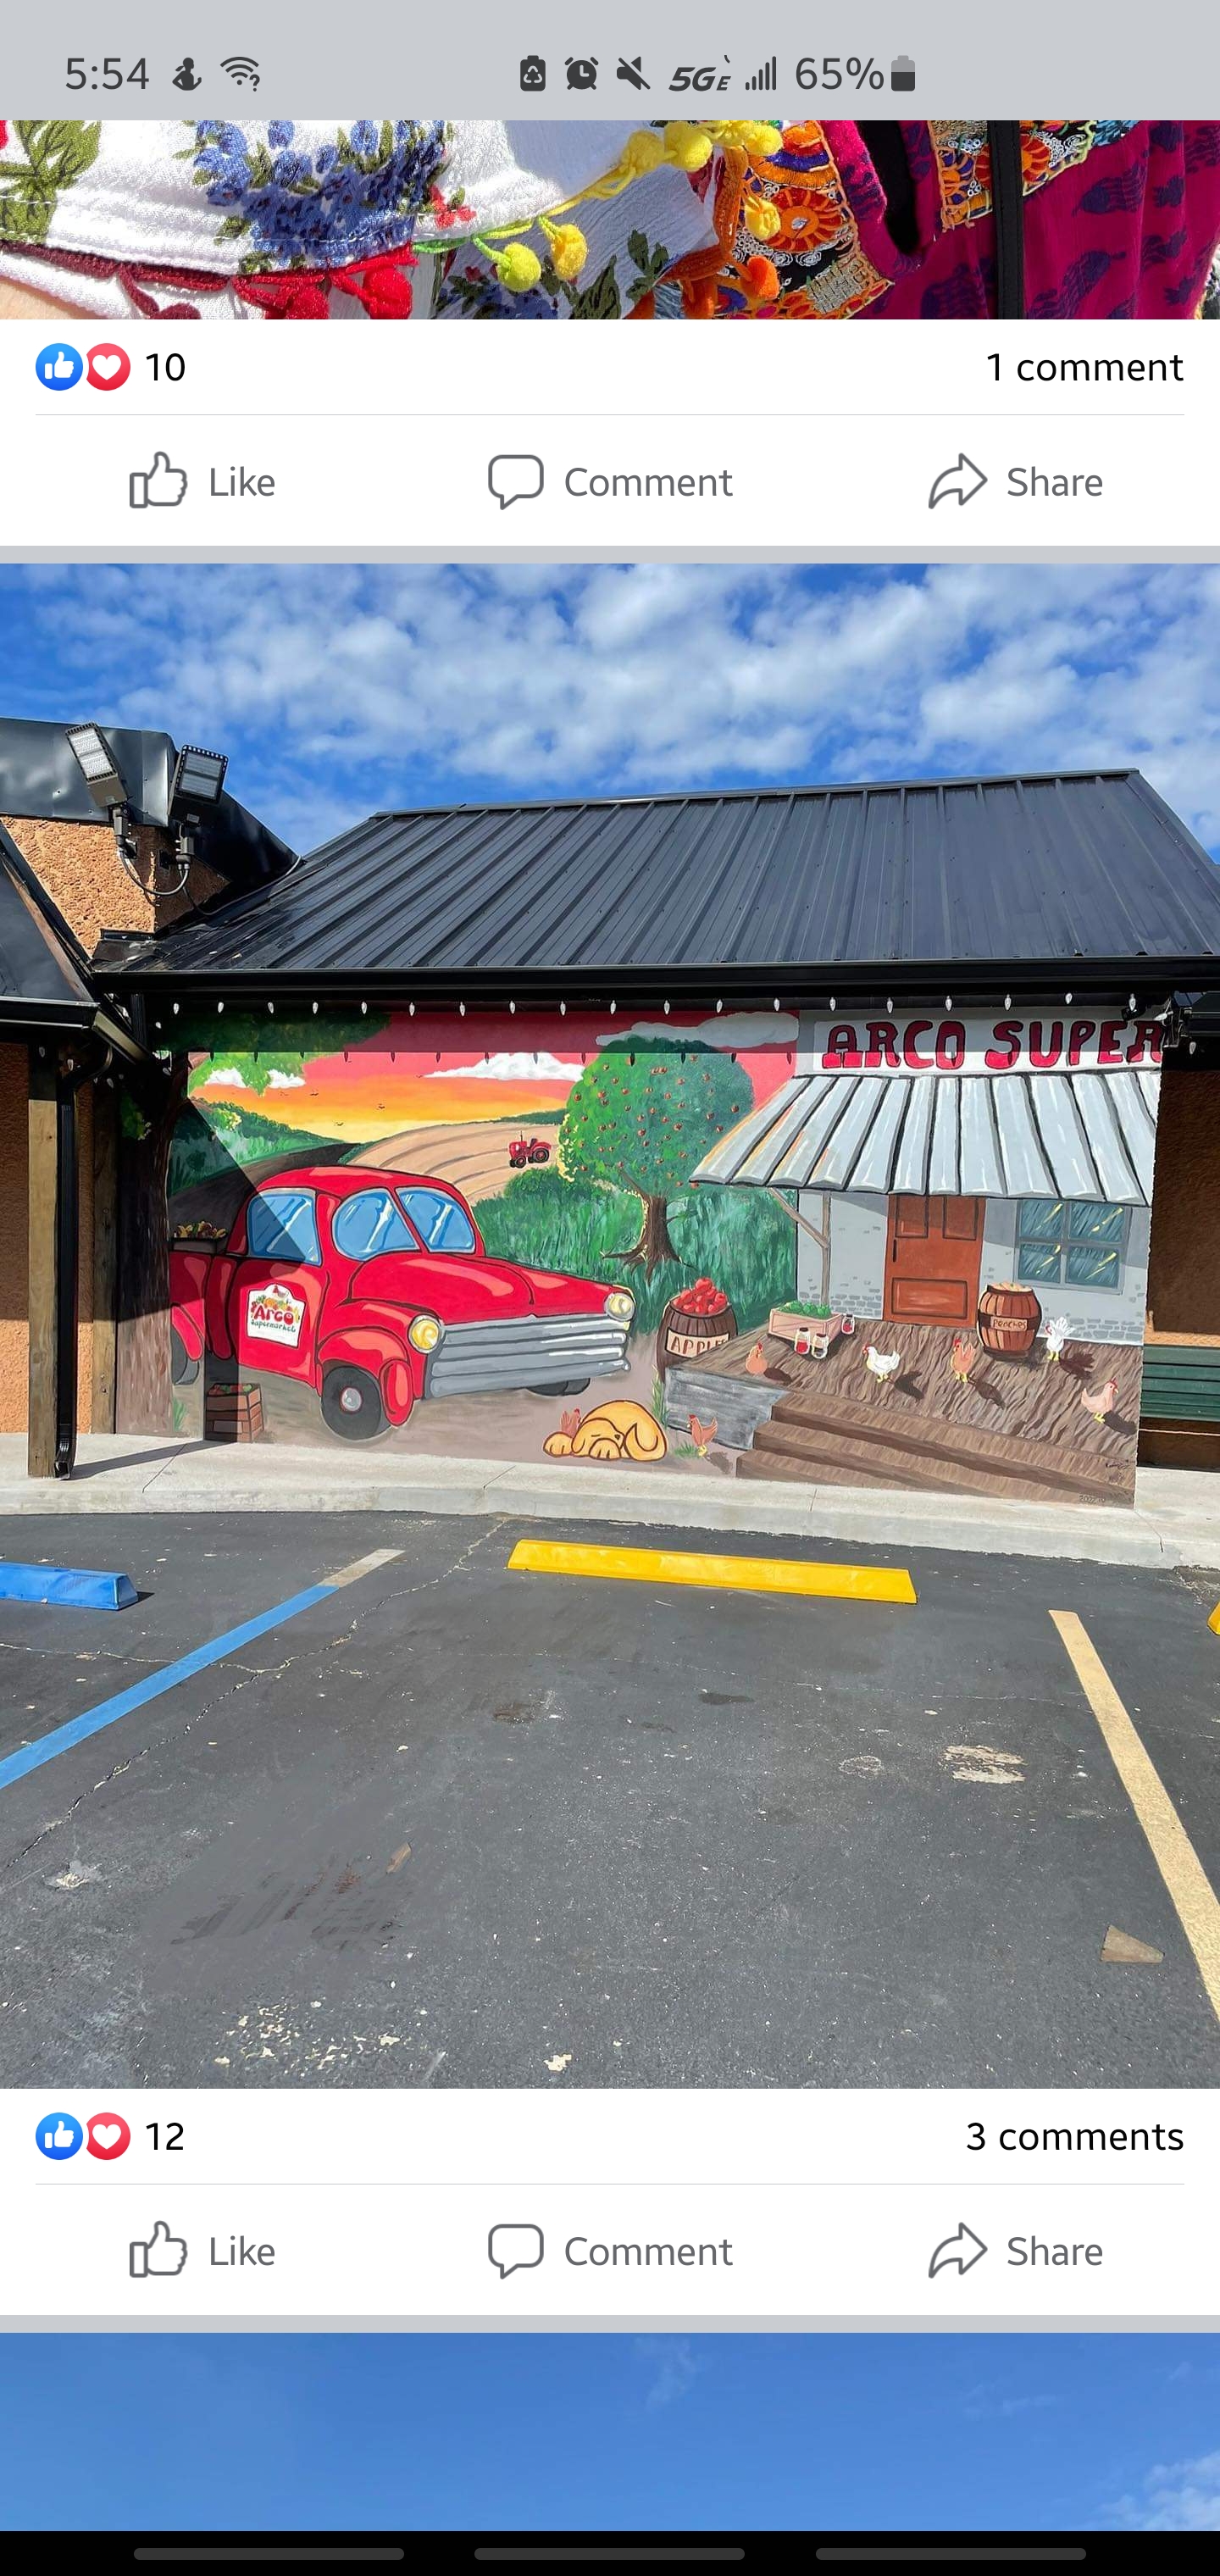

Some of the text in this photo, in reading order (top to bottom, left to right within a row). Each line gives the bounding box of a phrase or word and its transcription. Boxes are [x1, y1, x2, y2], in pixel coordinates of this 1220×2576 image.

[64, 57, 151, 91] 5:54
[796, 56, 885, 91] 65%
[145, 353, 186, 382] 10
[986, 353, 1184, 382] 1 comment
[209, 465, 275, 497] Like
[563, 467, 735, 497] Comment
[1006, 465, 1104, 497] Share
[821, 1019, 1163, 1070] ARCO SUPER
[253, 1304, 294, 1325] Arco
[145, 2122, 184, 2151] 12
[966, 2122, 1184, 2151] 3 comments
[209, 2235, 275, 2267] Like
[563, 2236, 735, 2267] Comment
[1006, 2235, 1104, 2267] Share
